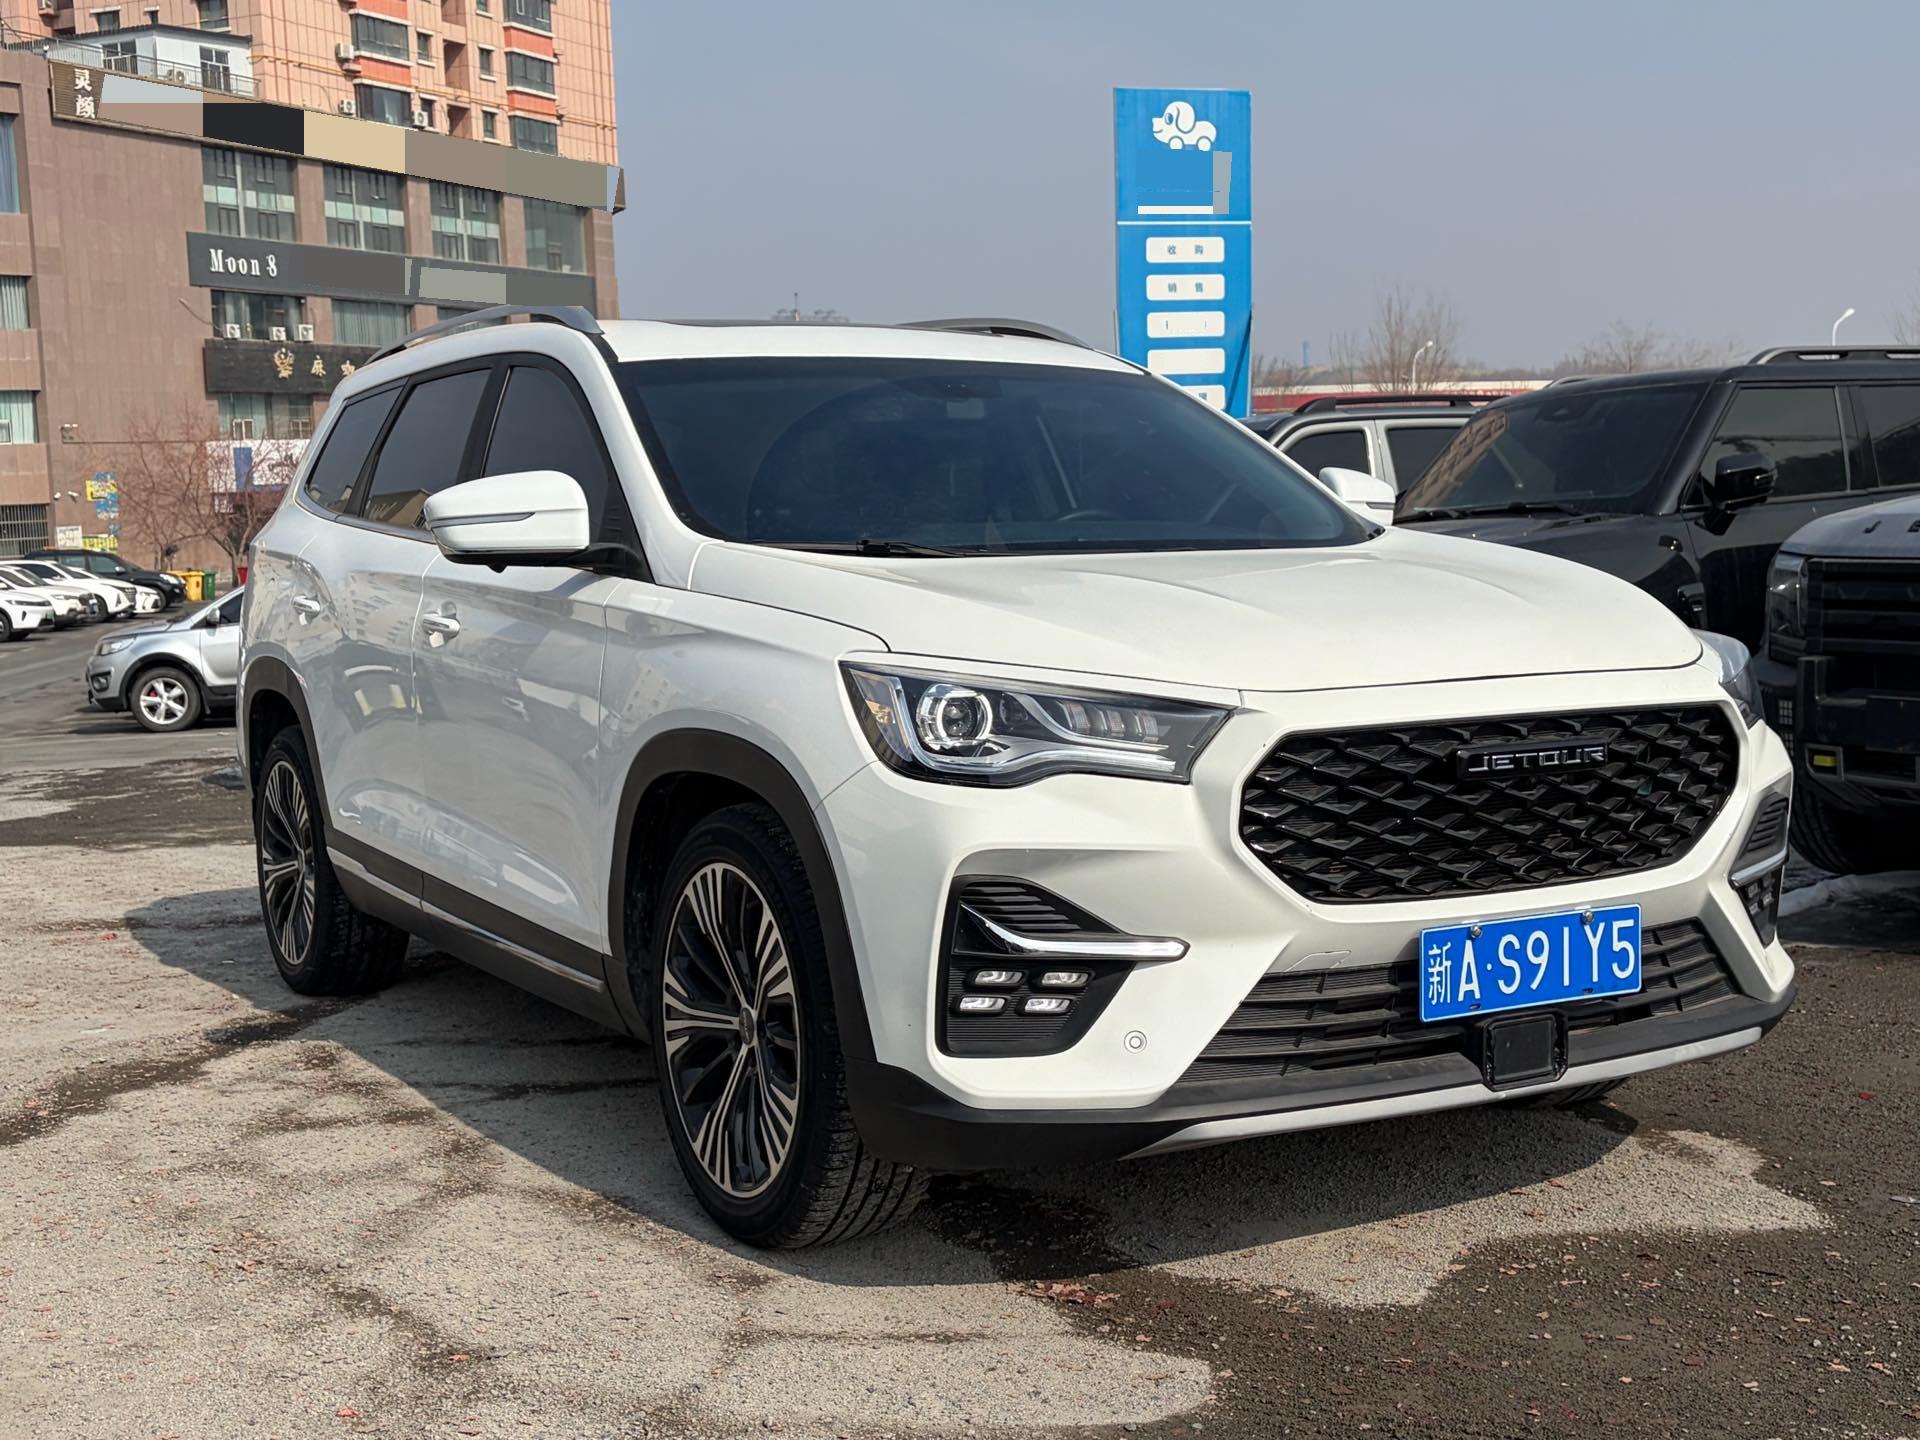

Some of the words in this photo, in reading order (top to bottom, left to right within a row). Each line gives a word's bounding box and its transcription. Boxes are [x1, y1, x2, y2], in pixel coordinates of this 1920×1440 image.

[209, 248, 261, 276] Moon
[266, 254, 278, 277] 8
[1468, 746, 1605, 772] JETOUR
